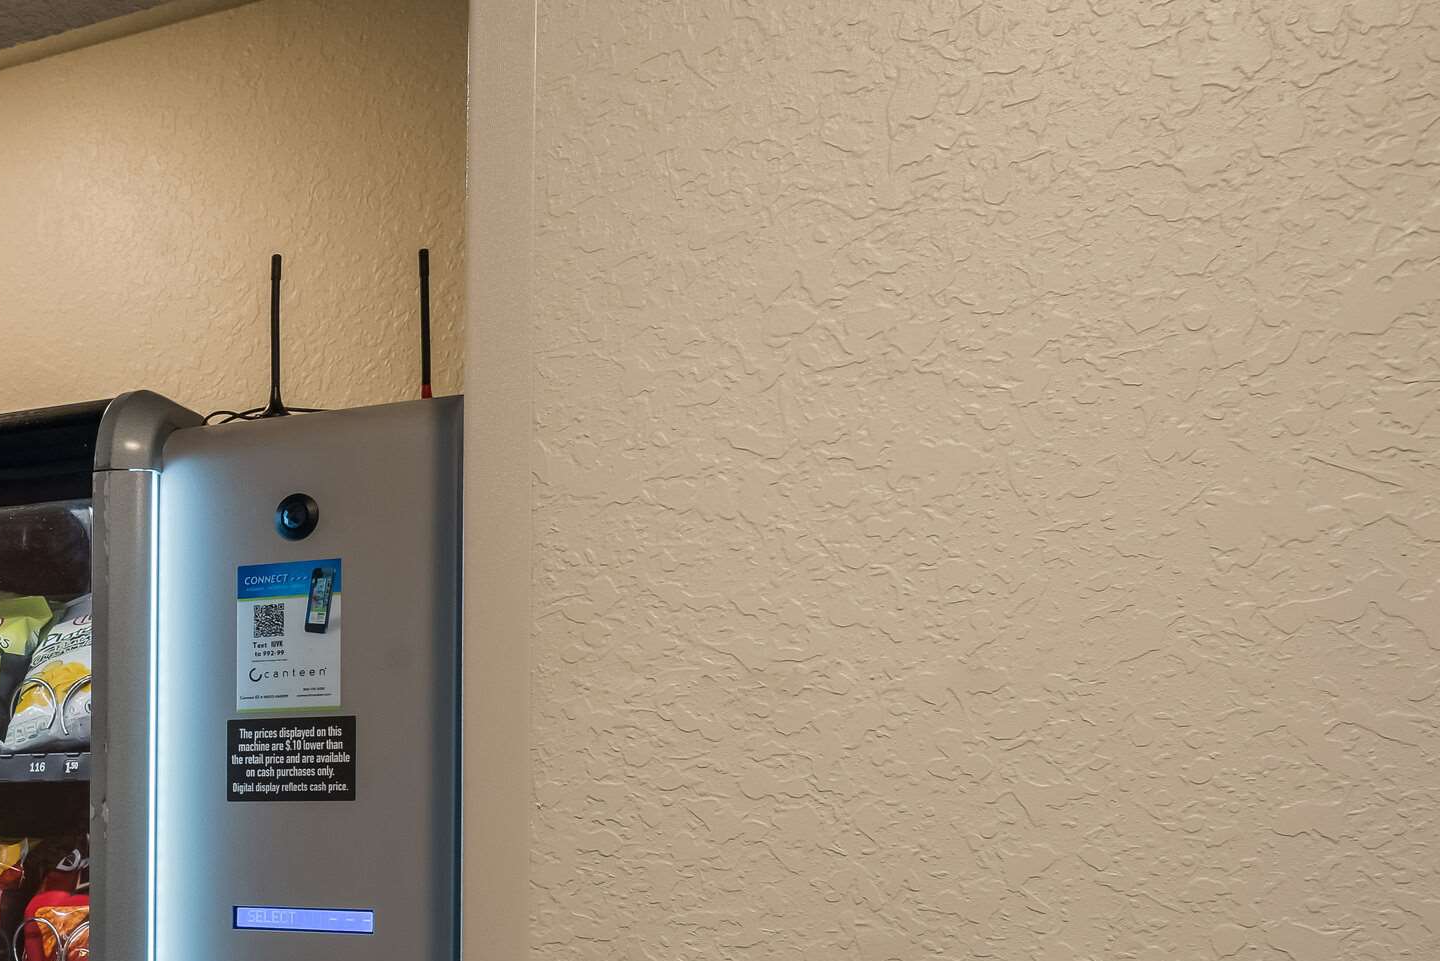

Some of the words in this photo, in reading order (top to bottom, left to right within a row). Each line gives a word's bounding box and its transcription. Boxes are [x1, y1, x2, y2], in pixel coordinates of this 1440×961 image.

[244, 574, 289, 585] CONNECT
[239, 728, 252, 739] The
[254, 728, 278, 741] prices
[279, 726, 315, 740] displayed
[316, 729, 326, 737] on
[328, 726, 342, 737] this
[238, 741, 270, 751] machine
[271, 743, 284, 751] are
[303, 740, 325, 750] lower
[326, 739, 343, 750] than
[231, 754, 244, 765] the
[244, 753, 264, 764] retail
[265, 753, 284, 767] price
[285, 753, 301, 764] and
[301, 755, 315, 763] are
[316, 752, 350, 763] available
[30, 762, 45, 772] 116
[246, 769, 256, 778] on
[257, 767, 275, 777] cash
[276, 766, 316, 779] purchases
[255, 782, 280, 794] display
[281, 781, 308, 792] reflects
[309, 782, 327, 791] cash
[247, 910, 296, 924] SELECT
